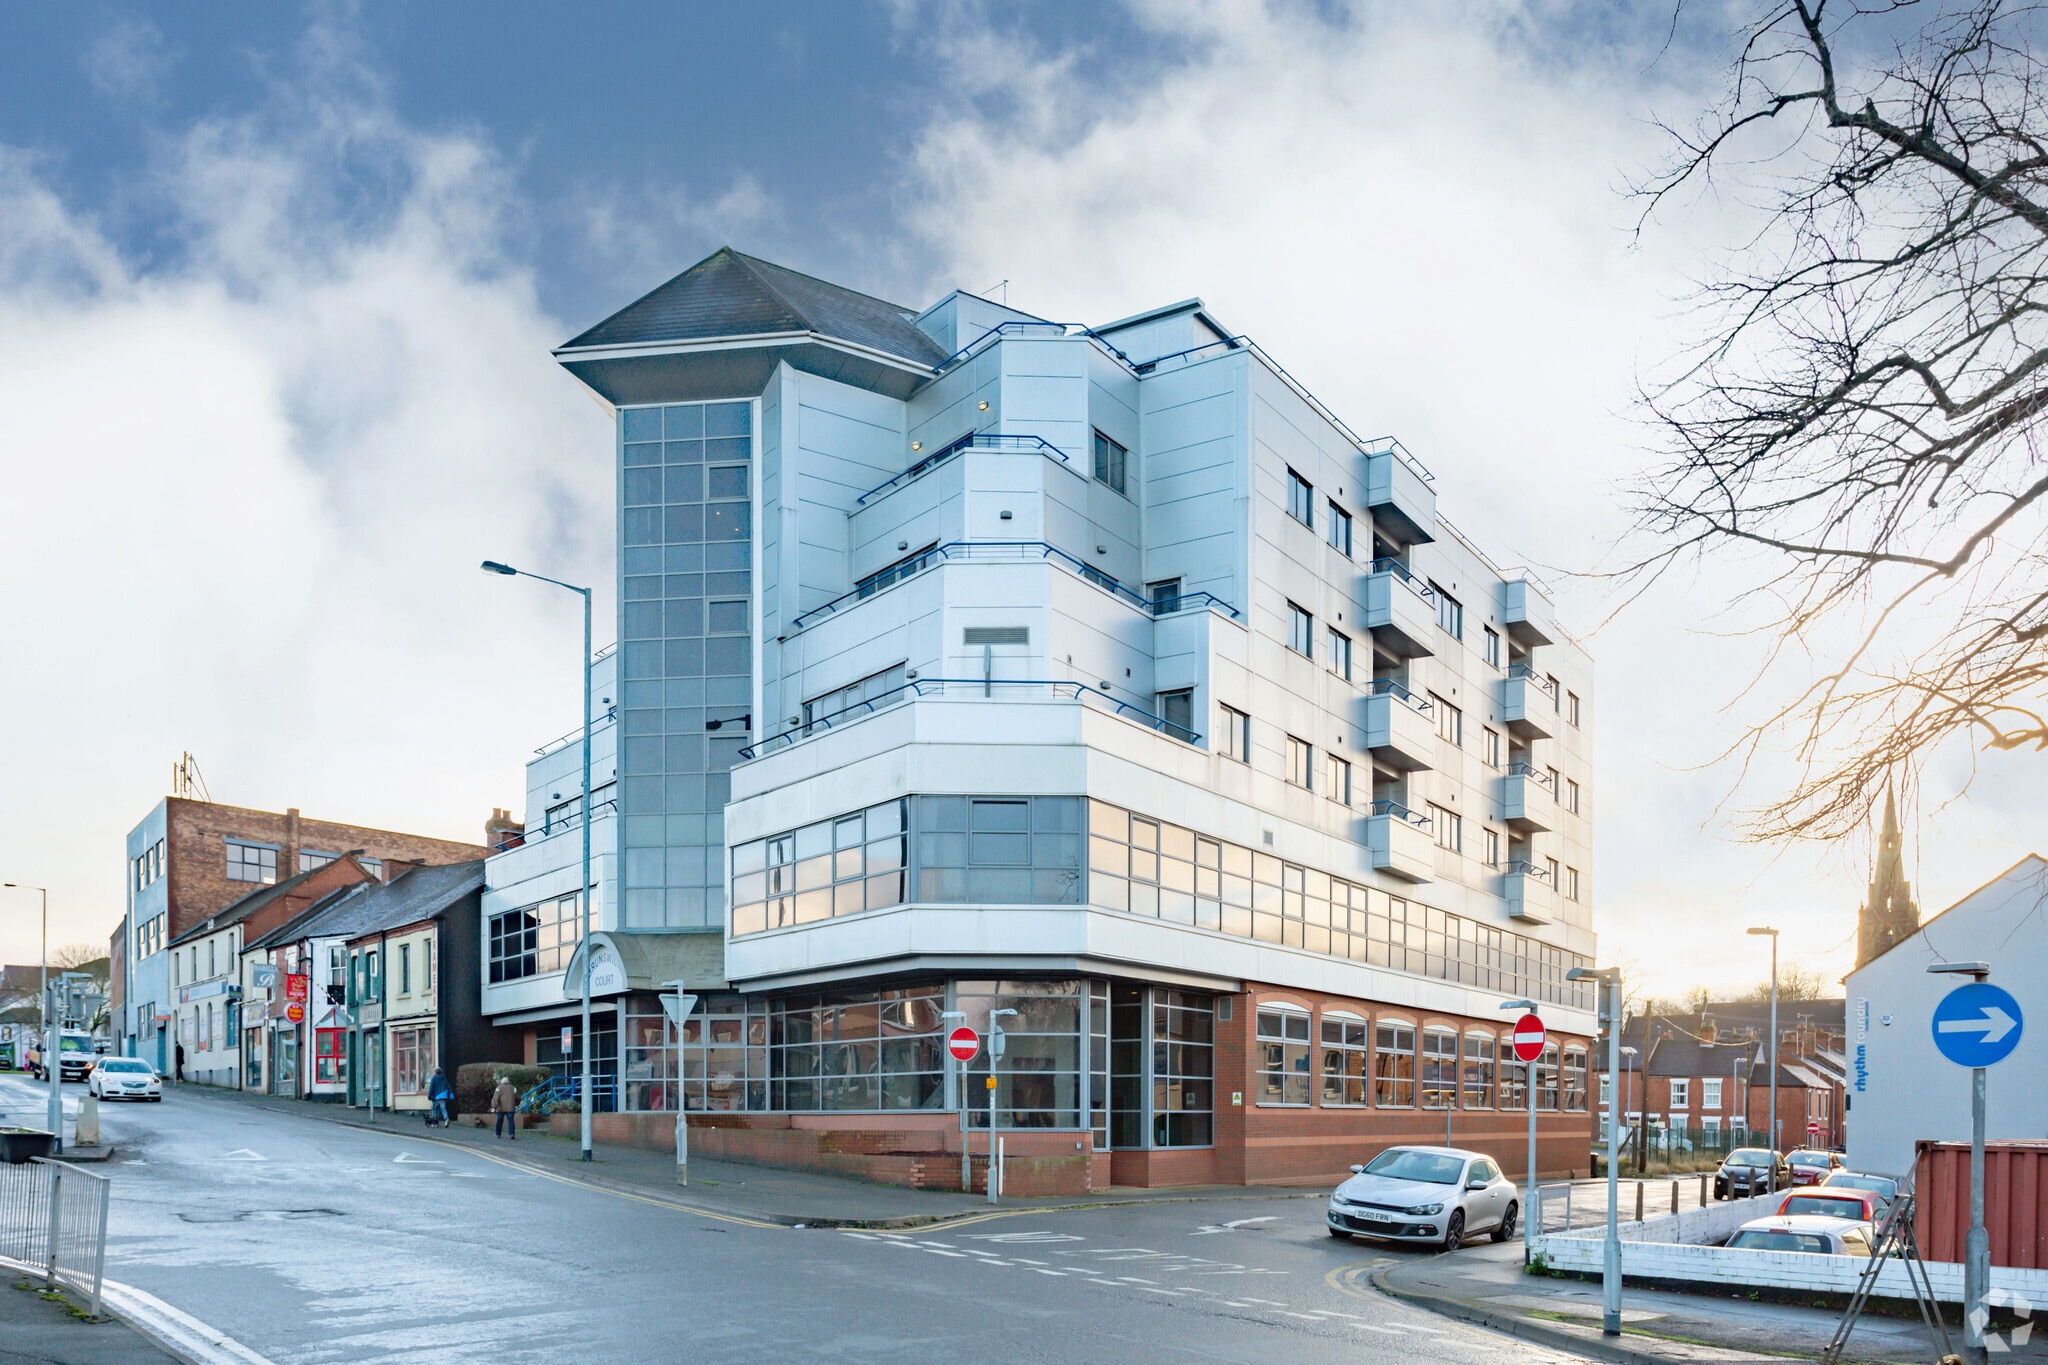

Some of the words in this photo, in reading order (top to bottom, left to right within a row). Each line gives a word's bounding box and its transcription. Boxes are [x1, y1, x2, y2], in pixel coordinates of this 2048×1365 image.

[595, 974, 615, 988] COURT
[1357, 1210, 1375, 1219] DG60
[1375, 1213, 1389, 1221] FRN
